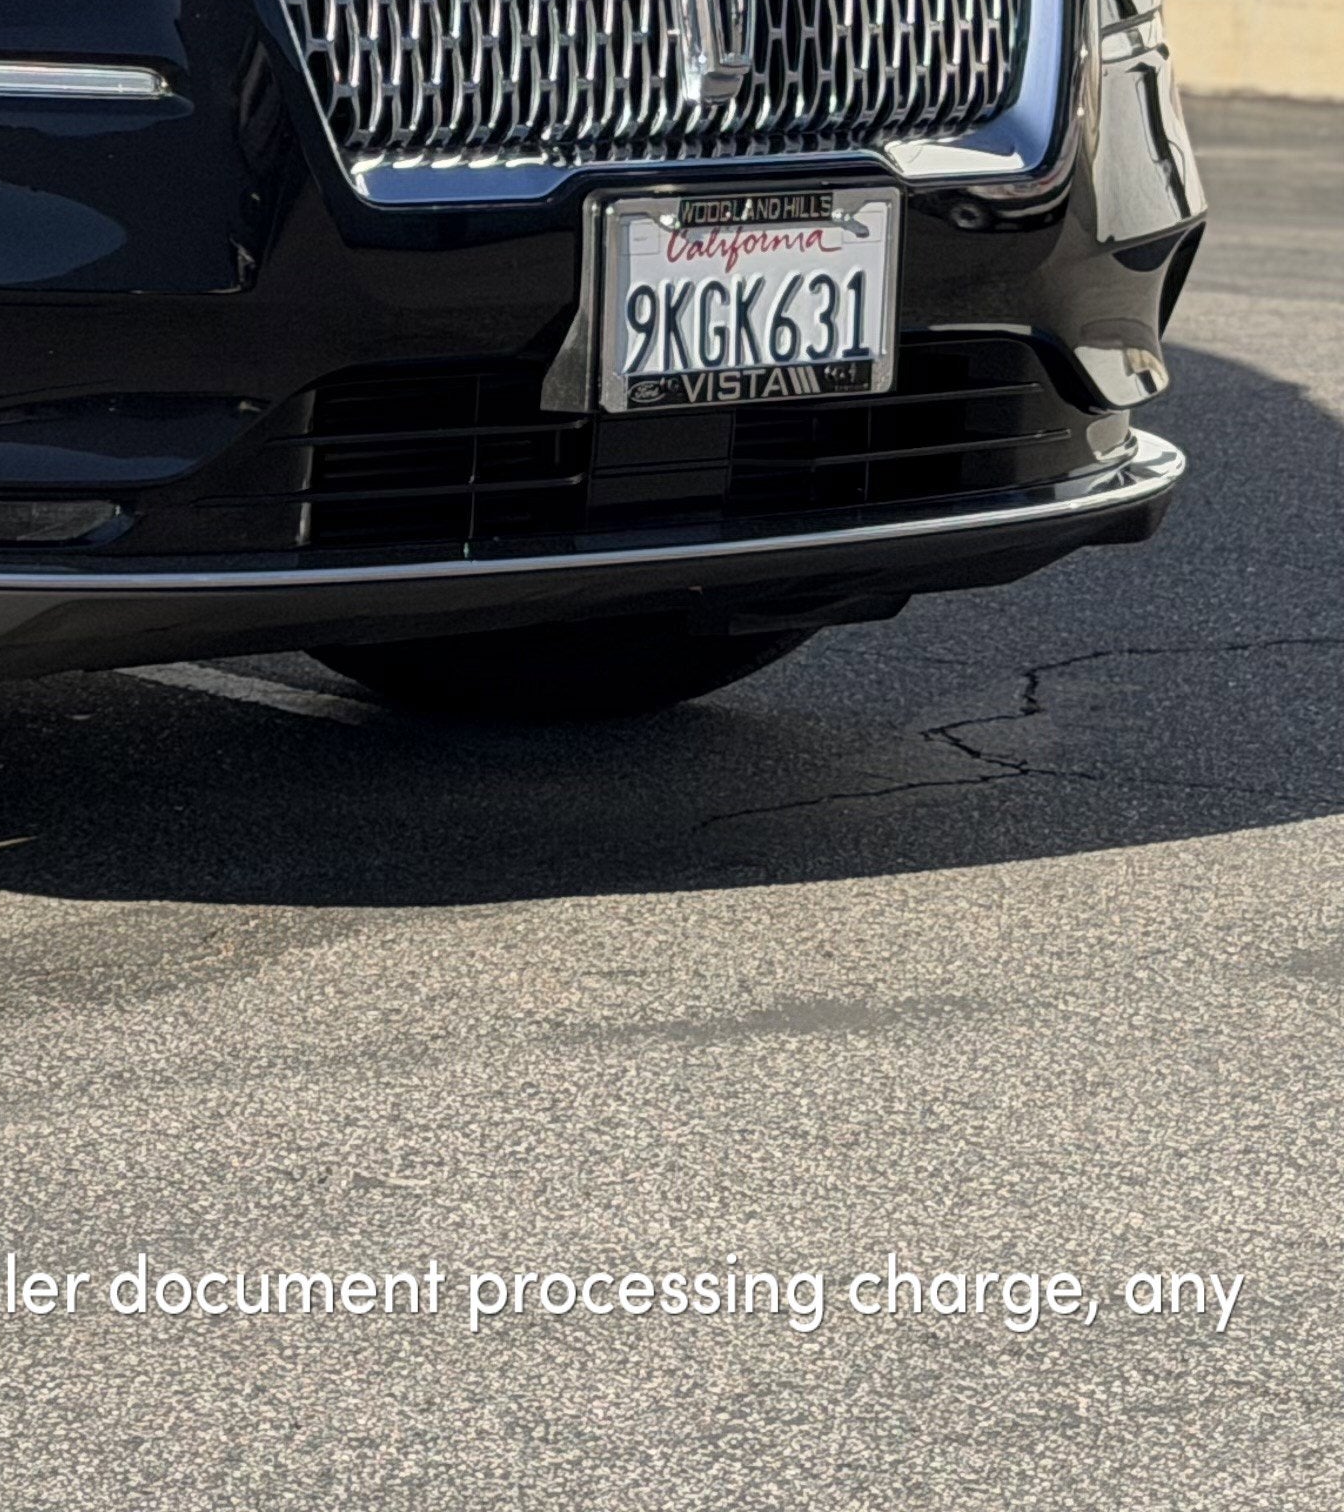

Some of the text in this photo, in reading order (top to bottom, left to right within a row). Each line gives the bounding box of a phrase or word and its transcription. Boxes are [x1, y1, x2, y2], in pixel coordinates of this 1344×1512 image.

[681, 196, 833, 223] WOODLAND HILLS
[667, 226, 842, 273] California
[625, 271, 870, 373] 9KGK631
[681, 368, 789, 404] VISTA
